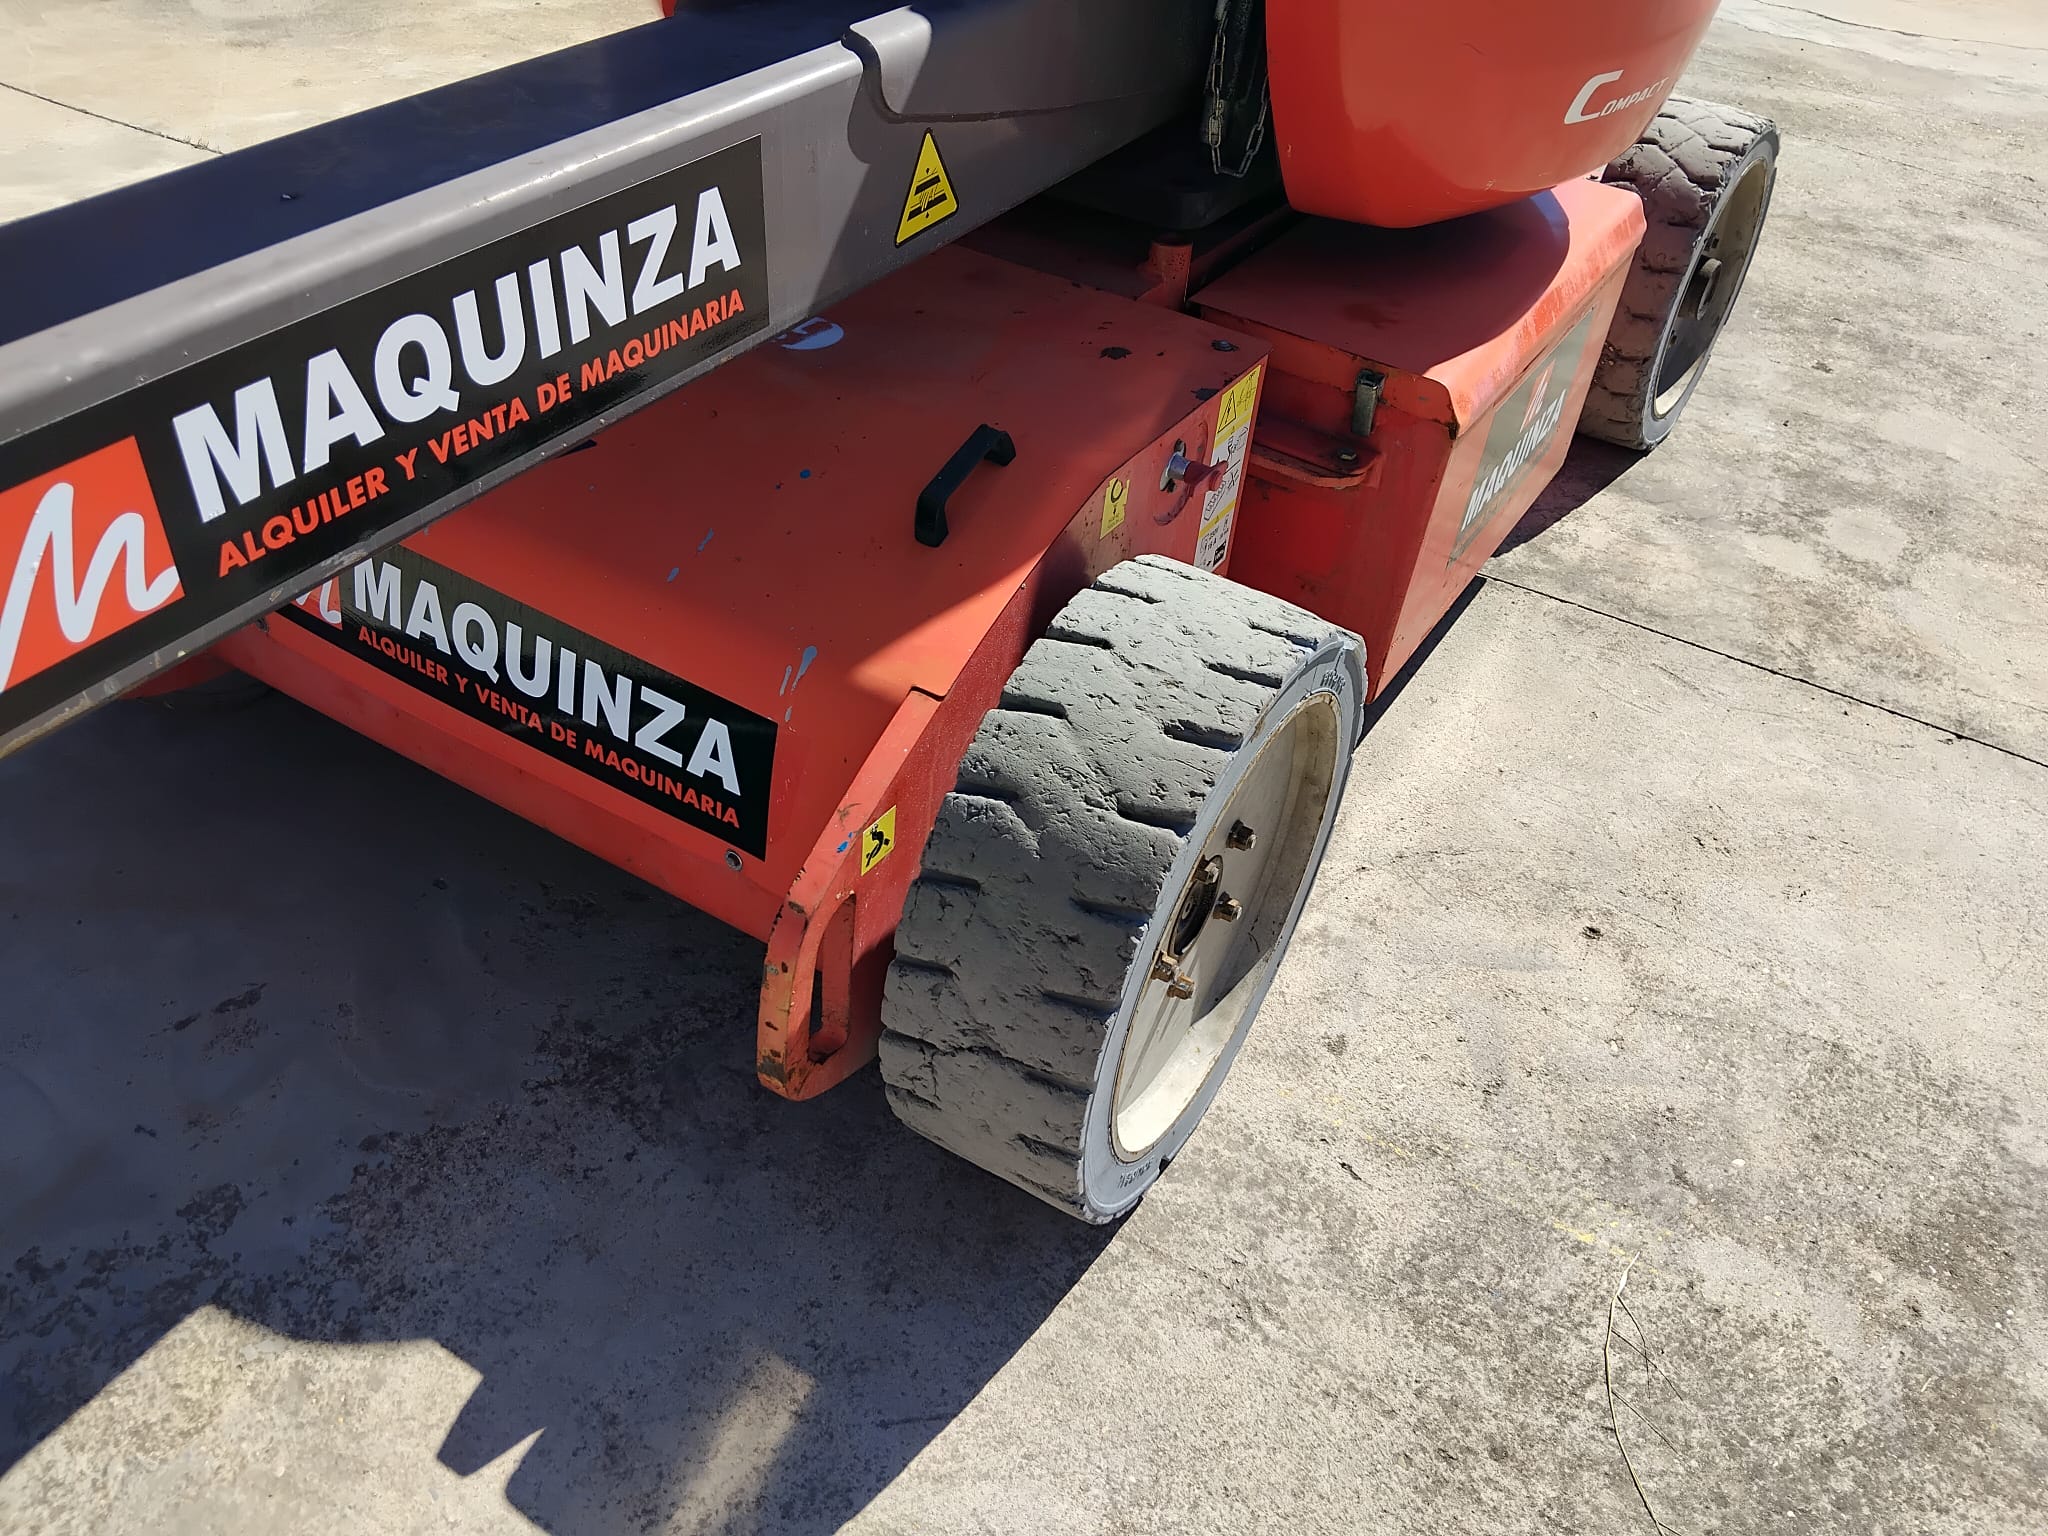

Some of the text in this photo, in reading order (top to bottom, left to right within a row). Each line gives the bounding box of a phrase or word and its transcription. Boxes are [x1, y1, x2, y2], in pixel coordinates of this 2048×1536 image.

[1564, 70, 1669, 124] COMPACT
[173, 187, 741, 522] MAQUINZA
[219, 289, 744, 576] ALQUILER Y VENTA DE MAQUINARIA
[1461, 389, 1566, 531] MAQUINZA
[354, 558, 740, 795] MAQUINZA
[359, 626, 740, 828] ALQUILER Y VENTA DE MAQUINARIA
